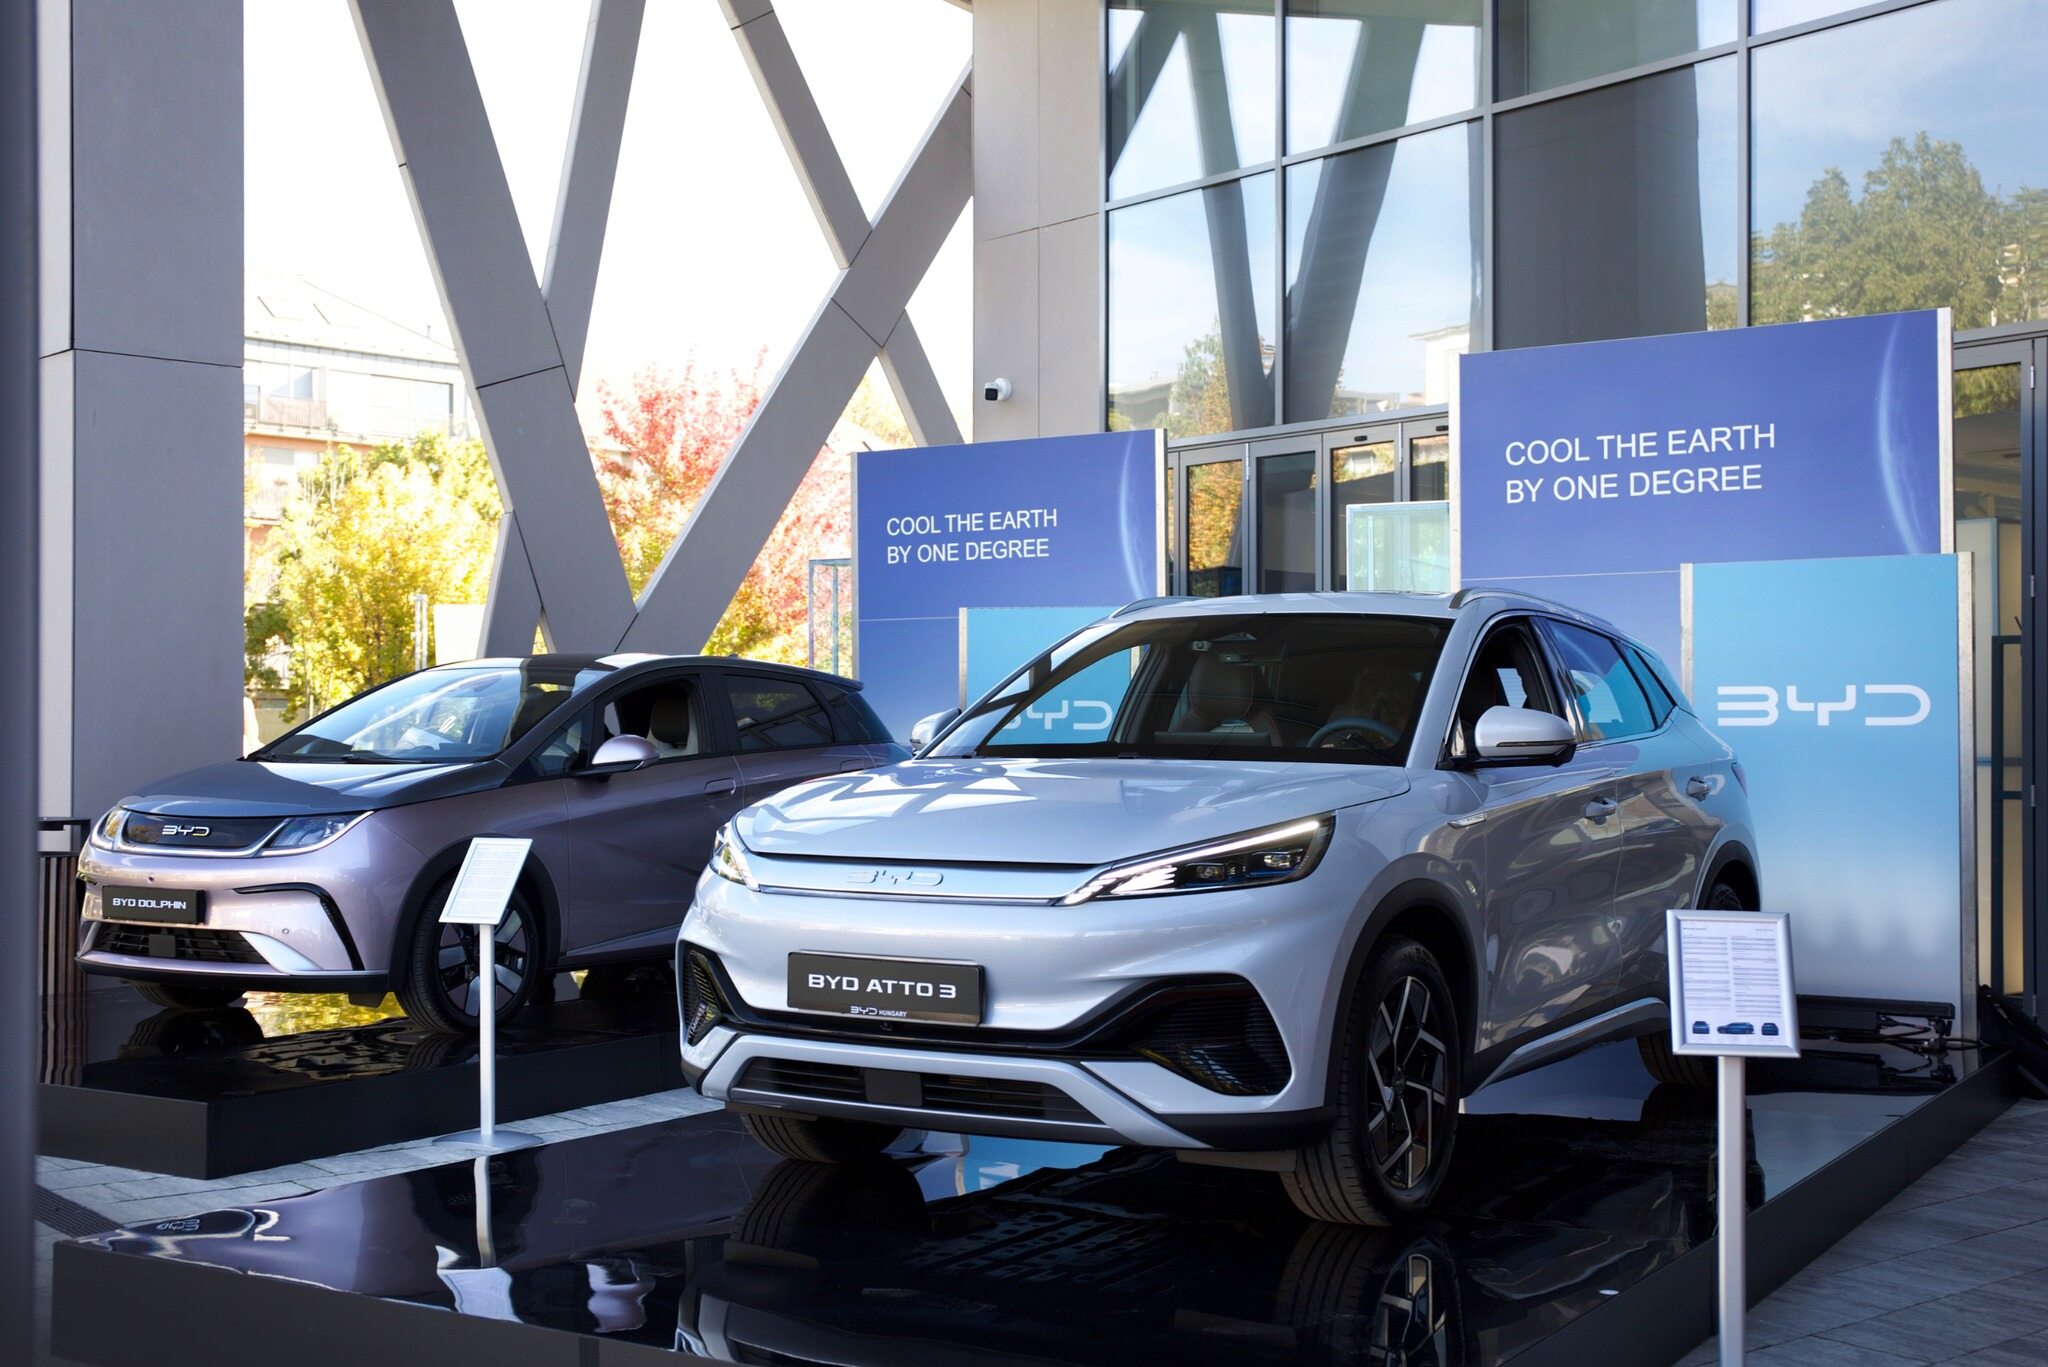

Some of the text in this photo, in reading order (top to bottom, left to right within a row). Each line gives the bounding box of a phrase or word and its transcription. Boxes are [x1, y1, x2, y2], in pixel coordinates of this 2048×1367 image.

[1505, 423, 1776, 466] COOL THE EARTH
[1506, 464, 1762, 504] BY ONE DEGREE
[886, 508, 1058, 536] COOL THE EARTH
[887, 538, 1050, 564] BY ONE DEGREE
[1003, 699, 1113, 730] YD
[1717, 684, 1931, 727] BYD
[162, 825, 210, 837] BYD
[847, 869, 944, 887] BYD
[112, 897, 187, 910] BYD DOLPHIN
[808, 973, 957, 999] BYD ATTO 3
[850, 1005, 907, 1017] BYD HUNGARY
